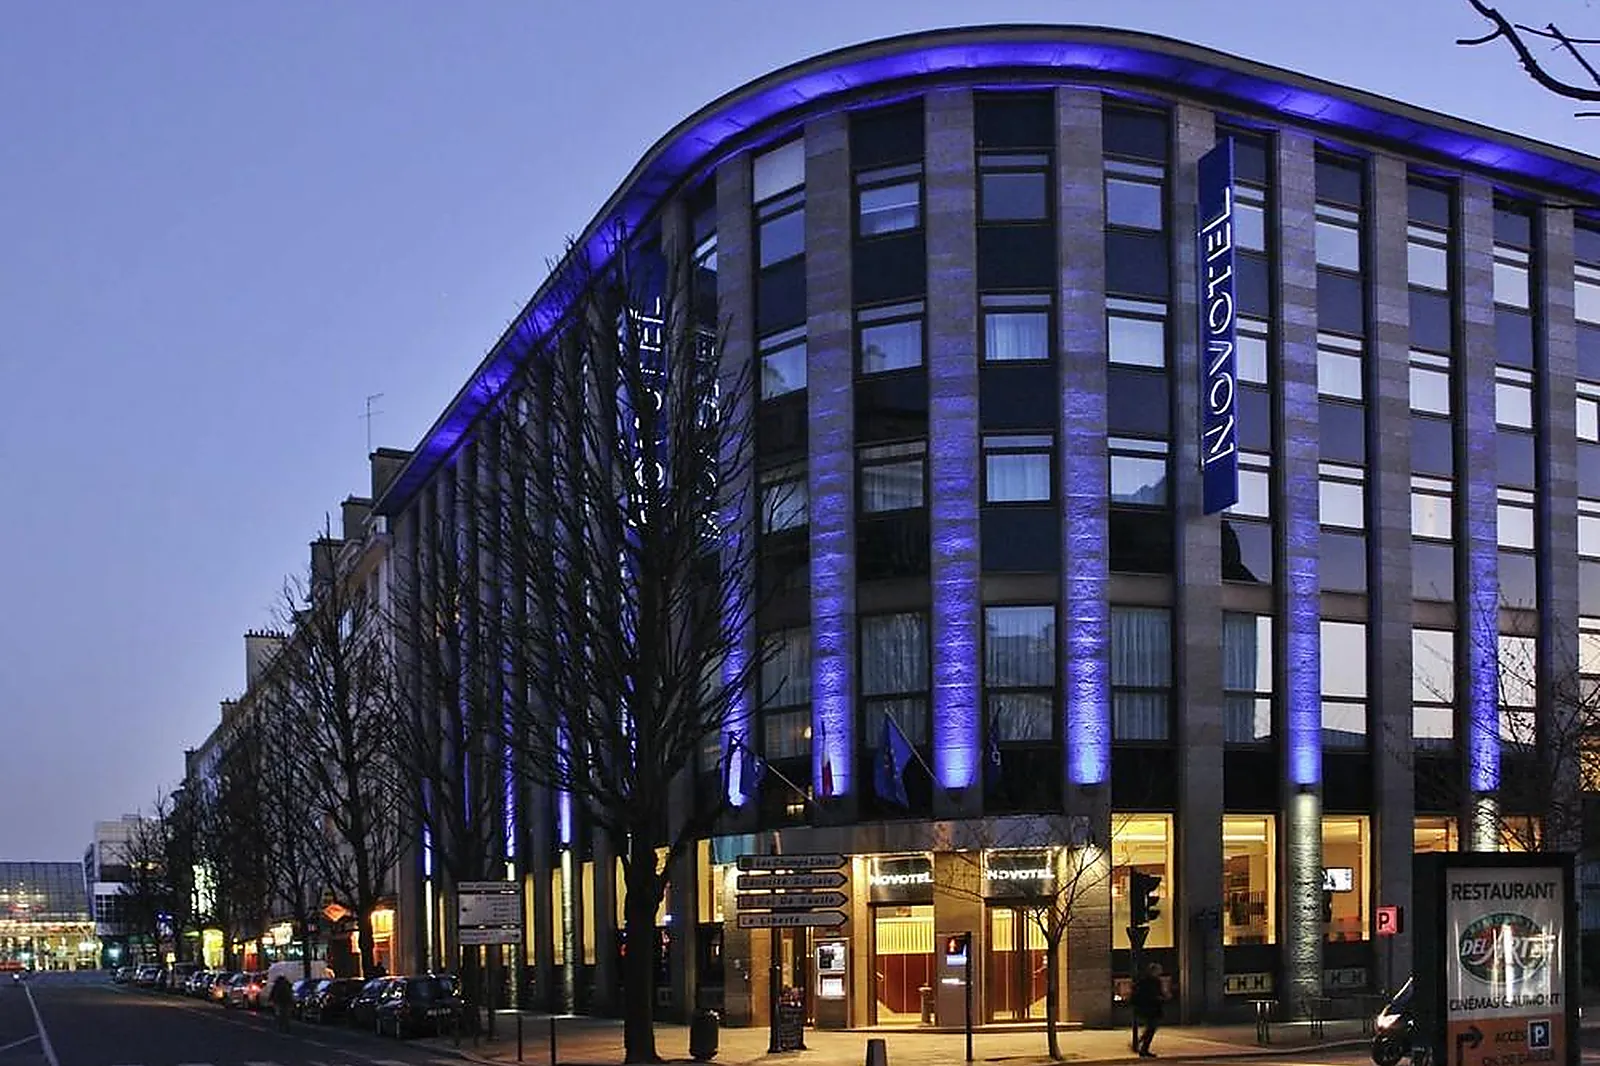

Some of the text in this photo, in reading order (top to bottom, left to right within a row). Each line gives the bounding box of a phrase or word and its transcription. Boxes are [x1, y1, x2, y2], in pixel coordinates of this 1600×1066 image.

[1198, 186, 1235, 465] NOVOTEL
[870, 871, 935, 886] NOVOTEL
[987, 868, 1056, 881] NOVOTEL
[1451, 882, 1558, 900] RESTAURANT
[1378, 912, 1391, 930] P
